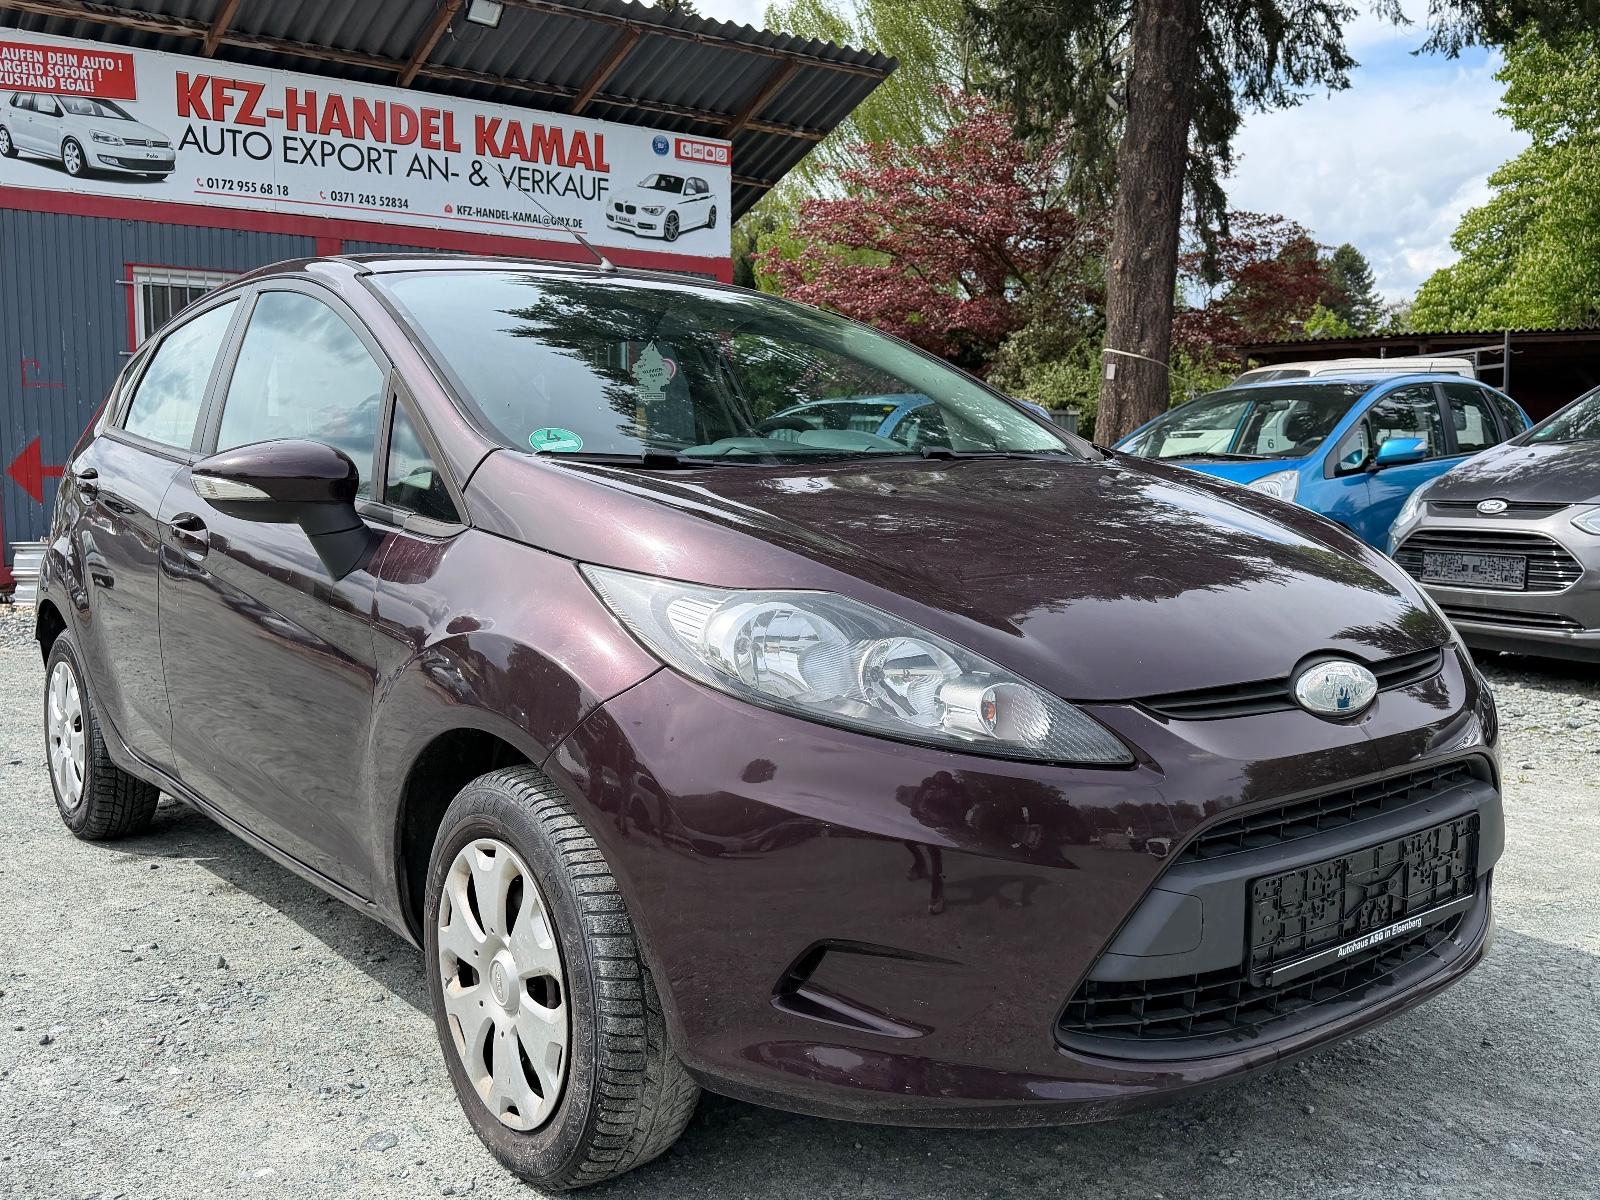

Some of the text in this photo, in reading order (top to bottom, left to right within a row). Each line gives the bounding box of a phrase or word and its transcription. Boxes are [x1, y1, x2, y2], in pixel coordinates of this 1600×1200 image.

[0, 47, 123, 72] AUFEN DEIN AUTO !
[0, 72, 95, 93] ZUSTAND EGAL!
[47, 64, 94, 80] SOFORT
[97, 69, 103, 81] !
[176, 70, 610, 173] KFZ-HANDEL KAMAL
[178, 124, 609, 201] AUTO EXPORT AN- & VERKAUF
[206, 178, 289, 196] 0172 955 68 18
[330, 190, 409, 209] 0371 243 52834
[457, 205, 583, 229] KFZ-HANDEL-KAMAL@GMX.DE
[1337, 938, 1368, 957] Autohaus
[1369, 931, 1384, 944] ASG
[1384, 929, 1391, 939] in
